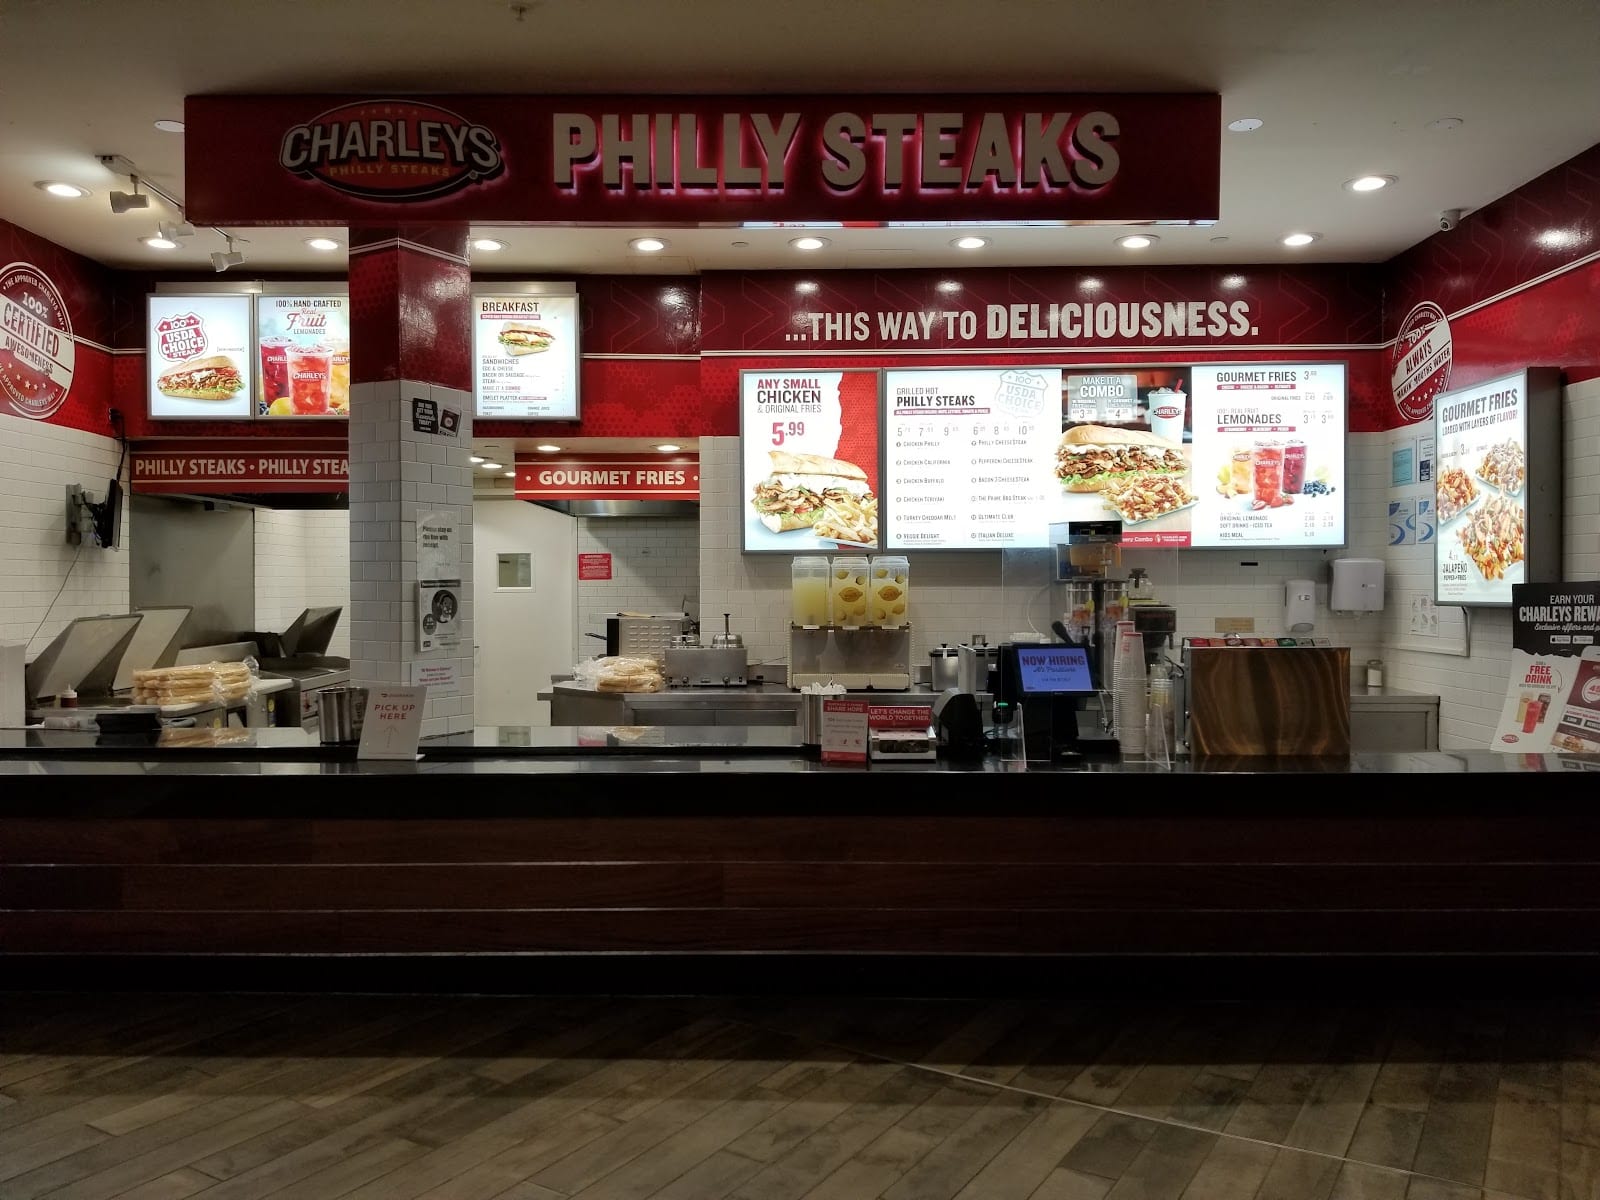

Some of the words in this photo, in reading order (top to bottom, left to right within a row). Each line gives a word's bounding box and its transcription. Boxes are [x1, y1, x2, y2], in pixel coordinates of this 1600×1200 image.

[281, 120, 501, 169] CHARLEYS
[552, 112, 801, 190] PHILLY
[822, 111, 1121, 190] STEAKS
[329, 165, 382, 177] PHILLY
[391, 165, 449, 177] STEAKS
[22, 292, 48, 319] 100%
[276, 299, 292, 308] 100%
[482, 302, 539, 312] BREAKFAST
[286, 312, 327, 331] Fruit
[877, 311, 936, 340] WAY
[942, 310, 977, 340] TO
[986, 300, 1259, 339] DELICIOUSNESS.
[4, 302, 59, 358] CERTIFIED
[166, 329, 197, 343] USDA
[162, 337, 205, 355] CHOICE
[5, 336, 54, 374] AWESOMENESS
[173, 348, 196, 359] STEAK
[1405, 339, 1433, 375] ALWAYS
[1413, 362, 1433, 386] MOUTHS
[1433, 347, 1451, 368] WATER
[1082, 377, 1105, 385] MAKE
[1106, 376, 1113, 385] IT
[1116, 376, 1122, 385] A
[1217, 371, 1266, 382] GOURMET
[1268, 371, 1297, 382] FRIES
[757, 378, 780, 390] ANY
[783, 378, 821, 390] SMALL
[896, 387, 924, 395] GRILLED
[925, 387, 939, 395] HOT
[1080, 385, 1124, 397] COMBO
[757, 390, 821, 404] CHICKEN
[1006, 385, 1036, 399] USDA
[896, 395, 933, 407] PHILLY
[935, 395, 975, 407] STEAKS
[999, 393, 1041, 410] CHOICE
[1442, 396, 1487, 423] GOURMET
[1489, 388, 1518, 412] FRIES
[757, 404, 764, 414] &
[765, 404, 799, 413] ORIGINAL
[800, 404, 822, 413] FRIES
[1217, 414, 1282, 425] LEMONADES
[1442, 425, 1458, 436] LOADED
[1459, 420, 1471, 432] WITH
[1471, 416, 1489, 430] LAYERS
[1489, 414, 1497, 425] OF
[771, 421, 805, 446] 5.99
[135, 459, 186, 476] PHILLY
[189, 459, 246, 476] STEAKS
[258, 458, 309, 475] PHILLY
[538, 470, 631, 485] GOURMET
[636, 470, 686, 485] FRIES
[1442, 561, 1468, 574] JALAPEÑO
[1550, 594, 1571, 604] EARN
[1572, 594, 1595, 604] YOUR
[1519, 605, 1572, 622] CHARLEYS
[1561, 622, 1582, 633] offers
[1022, 655, 1046, 666] NOW
[1048, 655, 1086, 666] HIRING
[1529, 665, 1551, 675] FREE
[1525, 674, 1552, 685] DRINK
[380, 712, 407, 720] HERE
